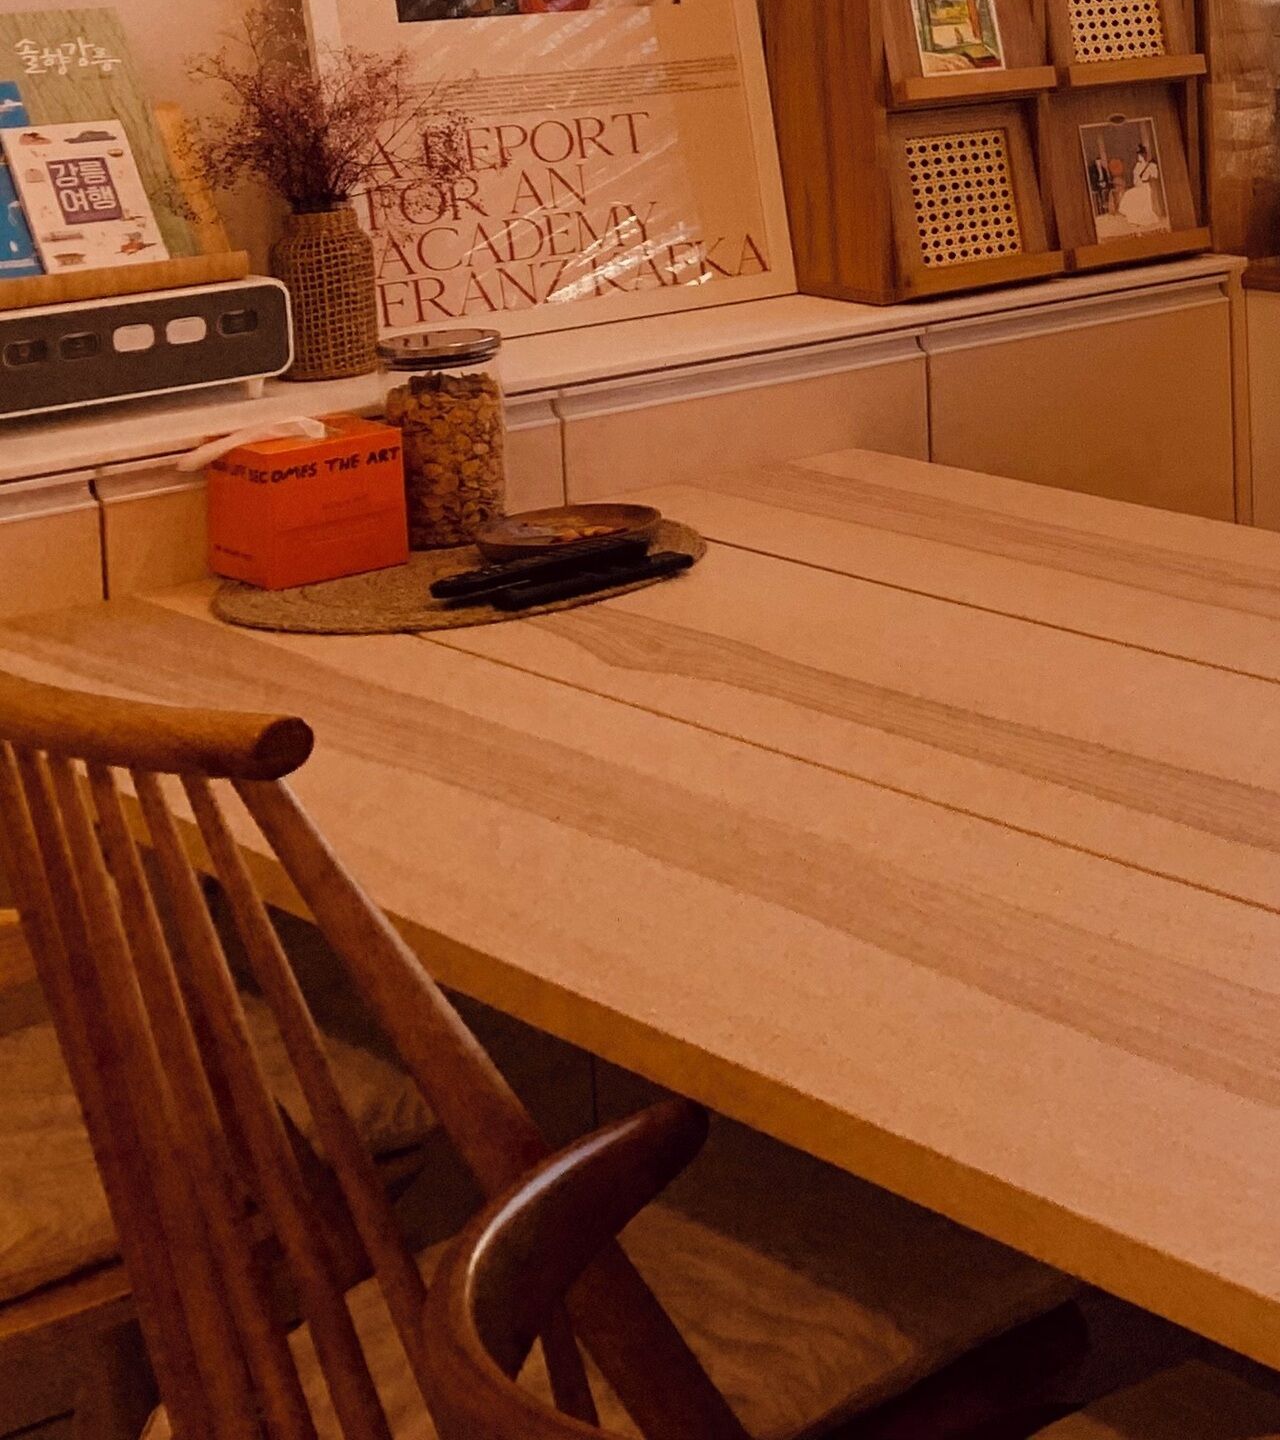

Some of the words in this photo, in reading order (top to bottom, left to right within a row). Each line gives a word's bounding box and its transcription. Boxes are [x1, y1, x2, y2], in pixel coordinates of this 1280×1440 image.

[49, 160, 107, 188] 강릉
[511, 163, 588, 215] AN
[59, 186, 117, 213] 여행
[376, 200, 658, 280] ACADEMY
[376, 258, 569, 329] FRANZ
[324, 453, 360, 473] THE
[366, 446, 401, 465] ART
